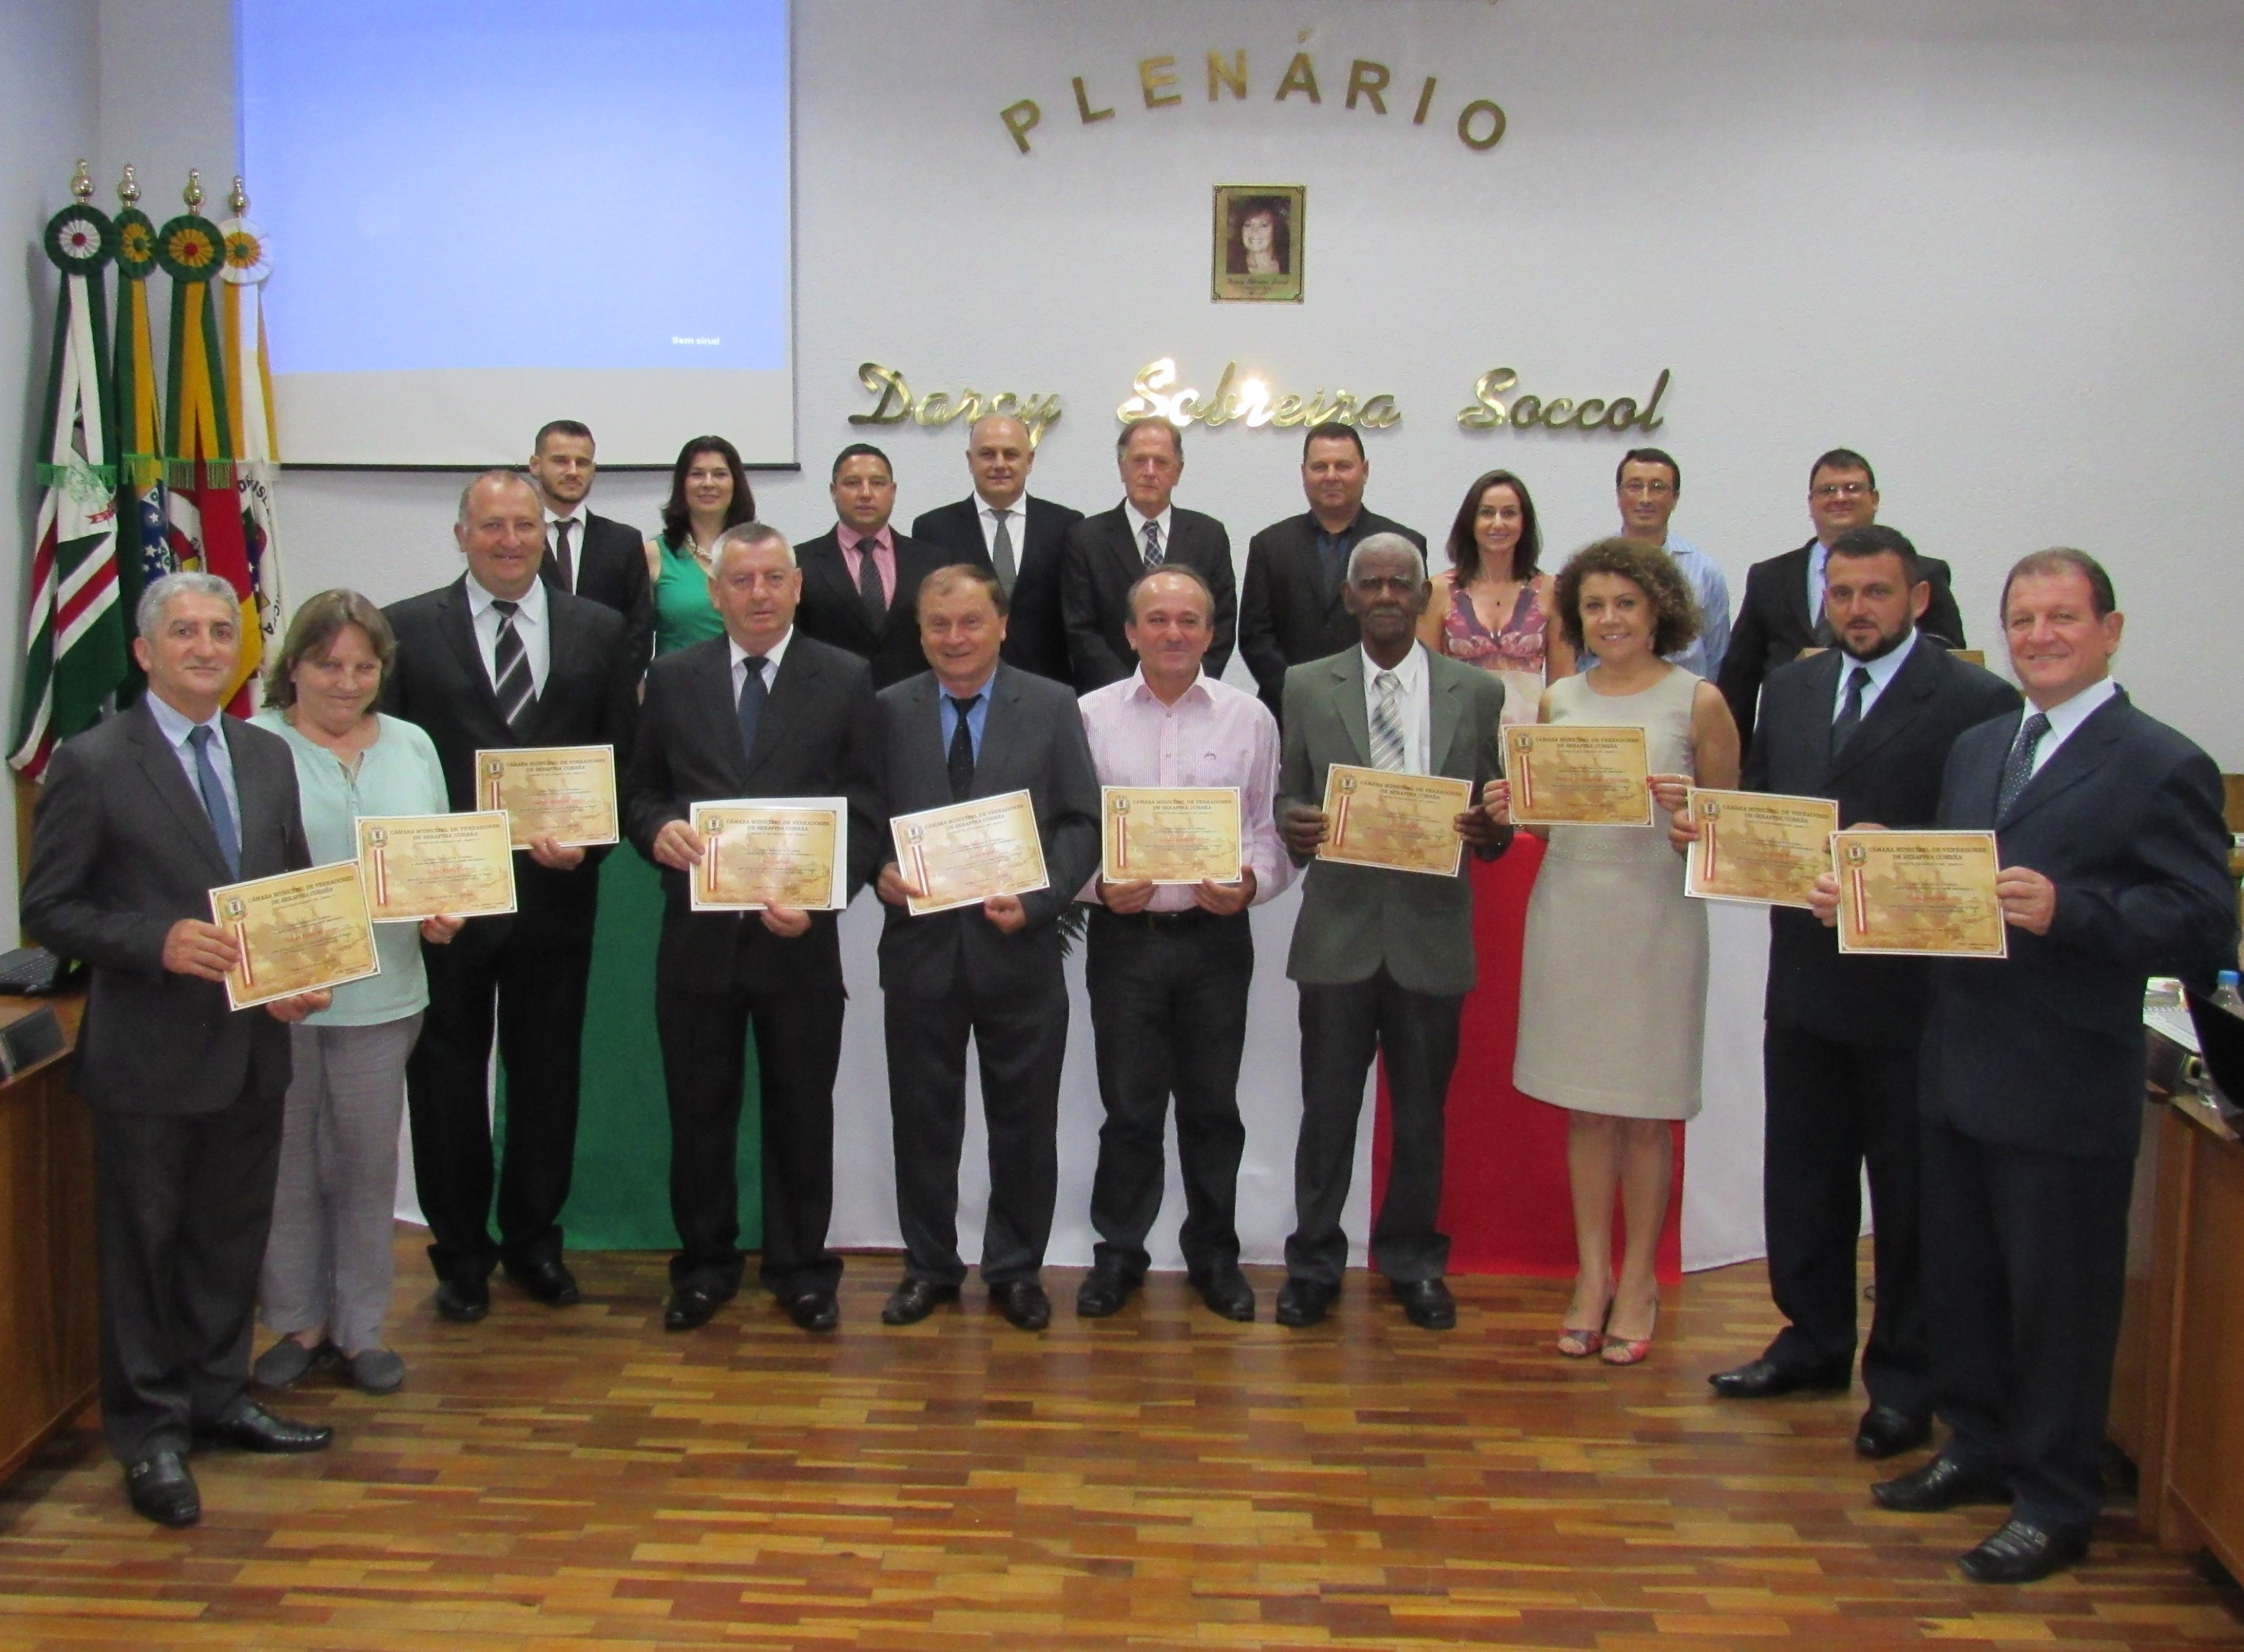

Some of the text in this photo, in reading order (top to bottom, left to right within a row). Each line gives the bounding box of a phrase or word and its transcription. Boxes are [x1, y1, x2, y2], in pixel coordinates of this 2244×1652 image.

[1000, 28, 1506, 154] PLENÁRIO
[672, 336, 720, 345] Sem sinal
[848, 362, 1062, 449] Darcy
[1456, 367, 1670, 432] Soccol
